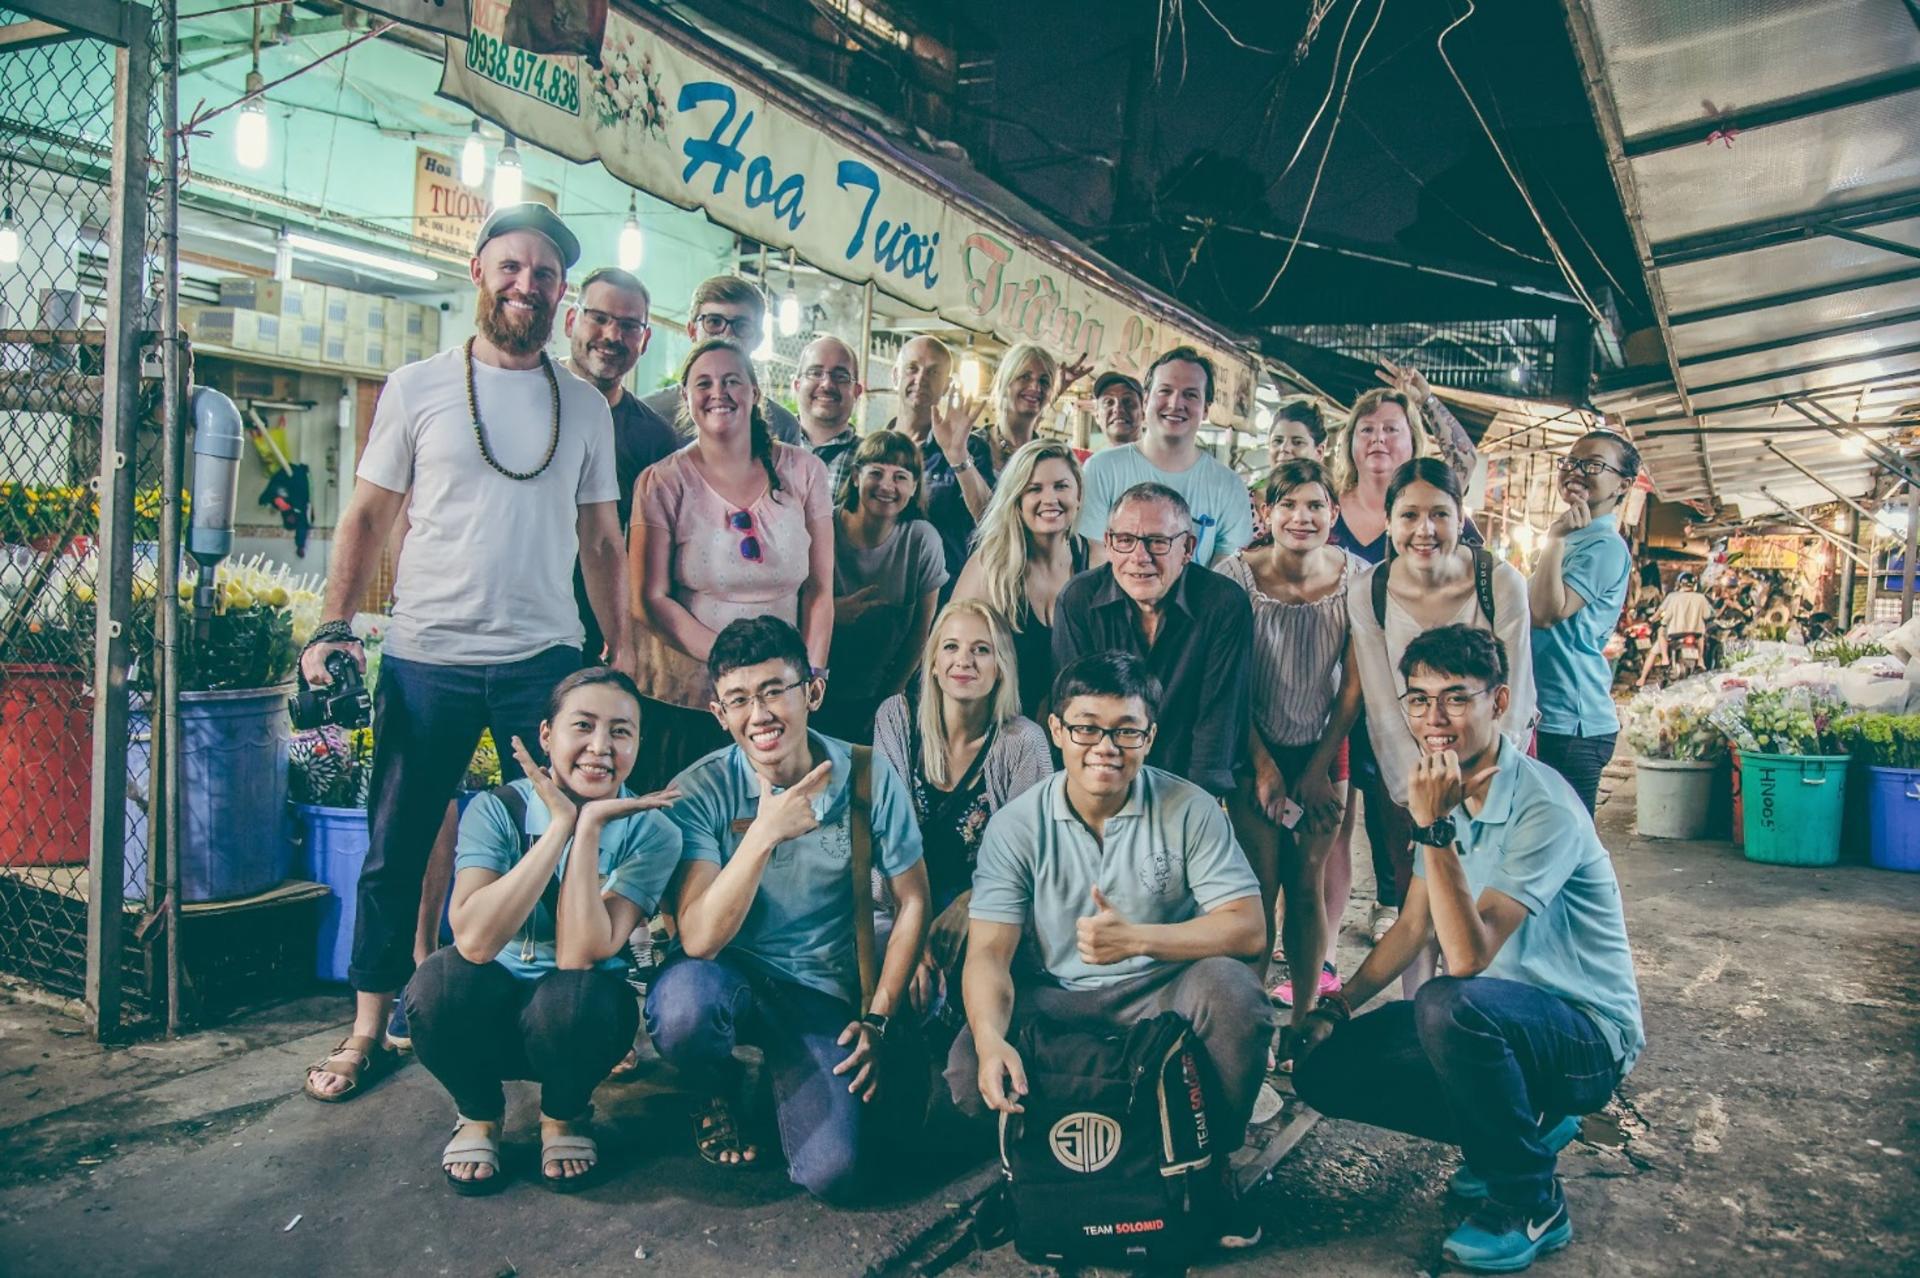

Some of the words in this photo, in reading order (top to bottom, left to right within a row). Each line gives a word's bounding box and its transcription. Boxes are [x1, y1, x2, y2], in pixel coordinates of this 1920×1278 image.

[468, 28, 579, 111] 0938.974.838
[424, 157, 451, 177] Hoa
[677, 81, 805, 232] Hoa
[837, 160, 940, 289] Tươi
[430, 183, 492, 223] TƯỜN
[1194, 1112, 1209, 1148] TEAM
[1083, 1225, 1113, 1236] TEAM
[1115, 1220, 1164, 1234] SOLOMID
